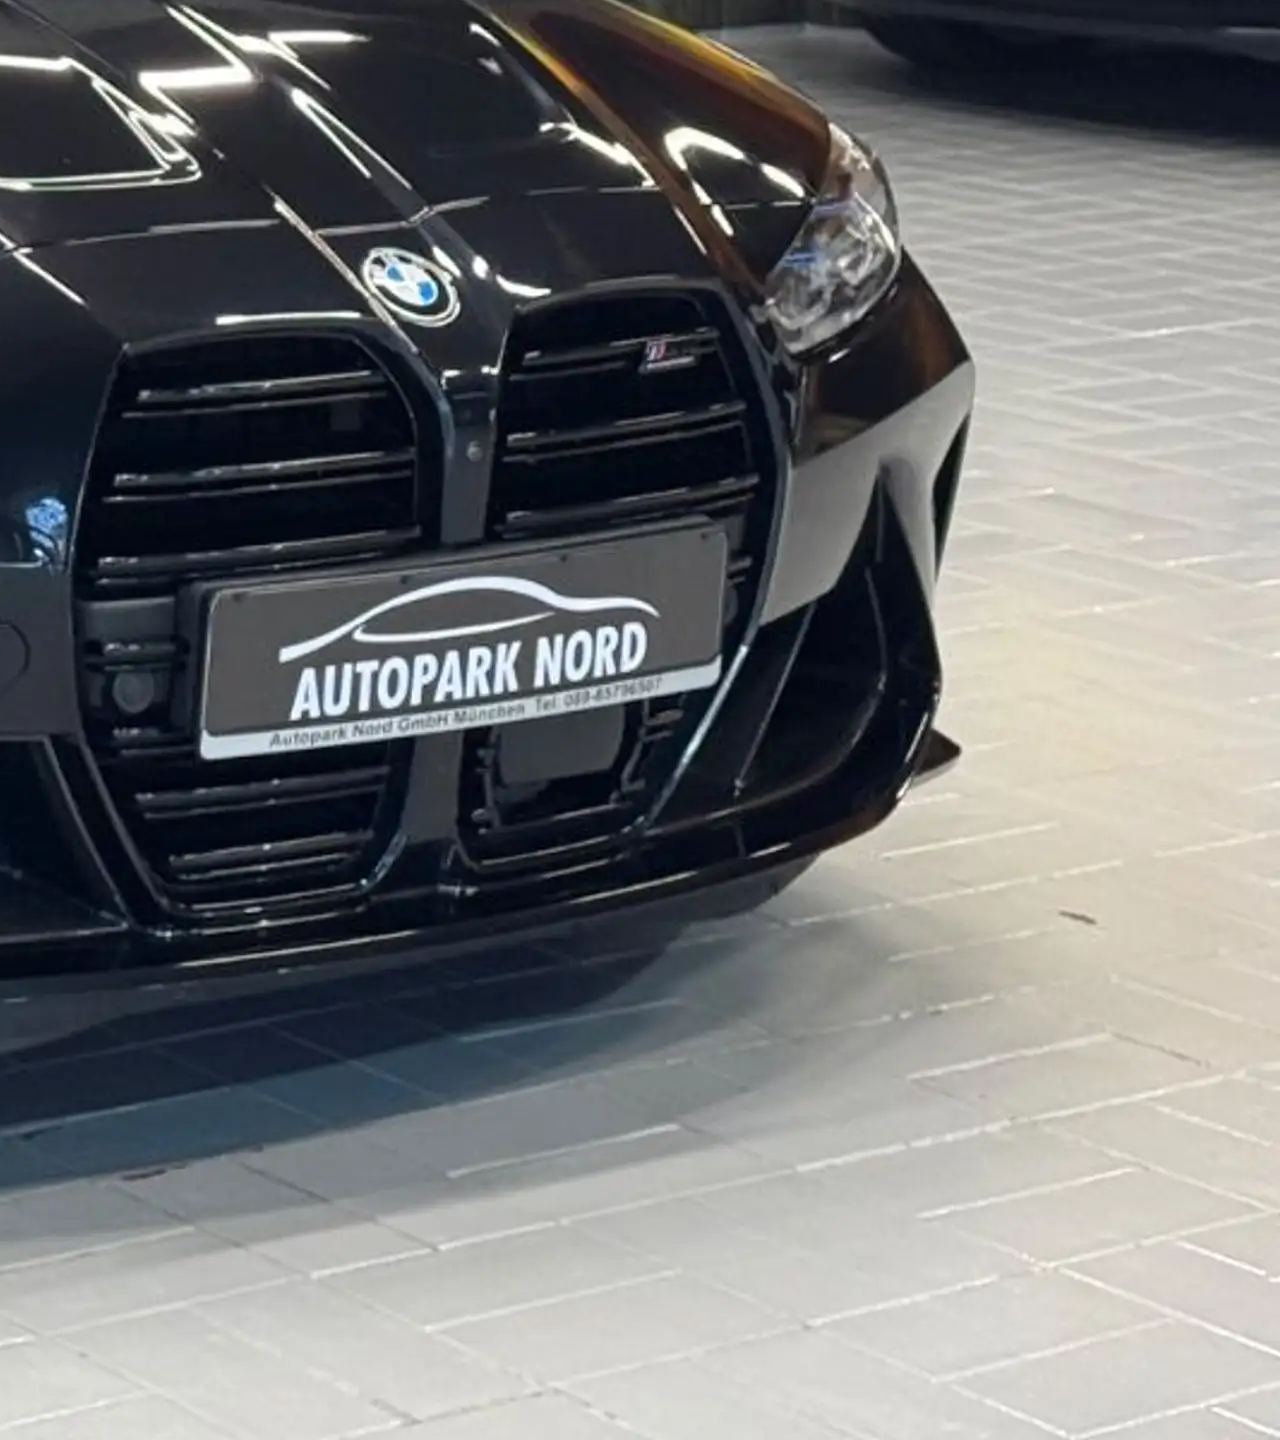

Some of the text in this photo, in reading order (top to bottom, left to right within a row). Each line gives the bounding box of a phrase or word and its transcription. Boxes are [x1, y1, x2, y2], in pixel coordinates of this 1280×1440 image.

[289, 621, 649, 721] AUTOPARK NORD
[268, 726, 347, 749] Autopark
[353, 718, 394, 738] Nord
[397, 711, 450, 733] GmbH
[454, 701, 526, 725] München
